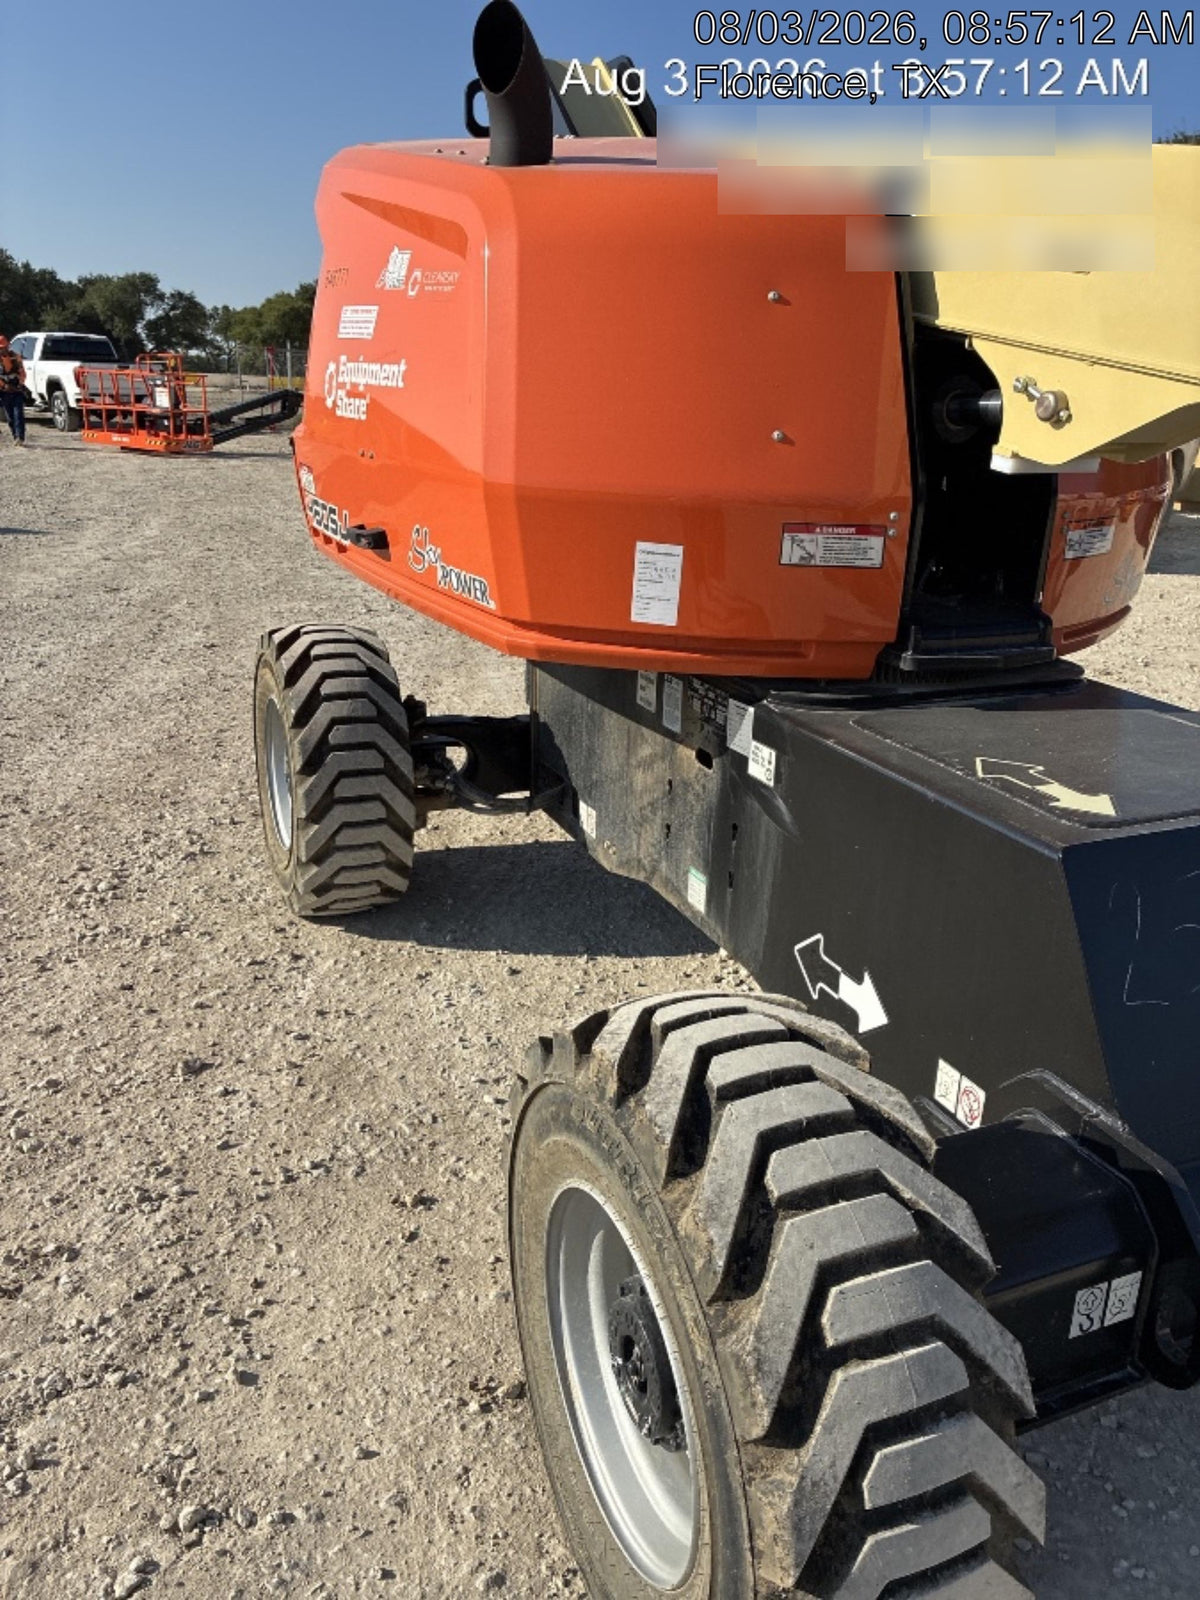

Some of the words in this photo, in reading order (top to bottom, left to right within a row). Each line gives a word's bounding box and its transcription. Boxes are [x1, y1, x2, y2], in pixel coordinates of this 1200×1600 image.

[337, 355, 407, 392] Equipment
[335, 388, 368, 421] Share
[408, 523, 443, 574] Sky
[437, 563, 493, 608] POWER
